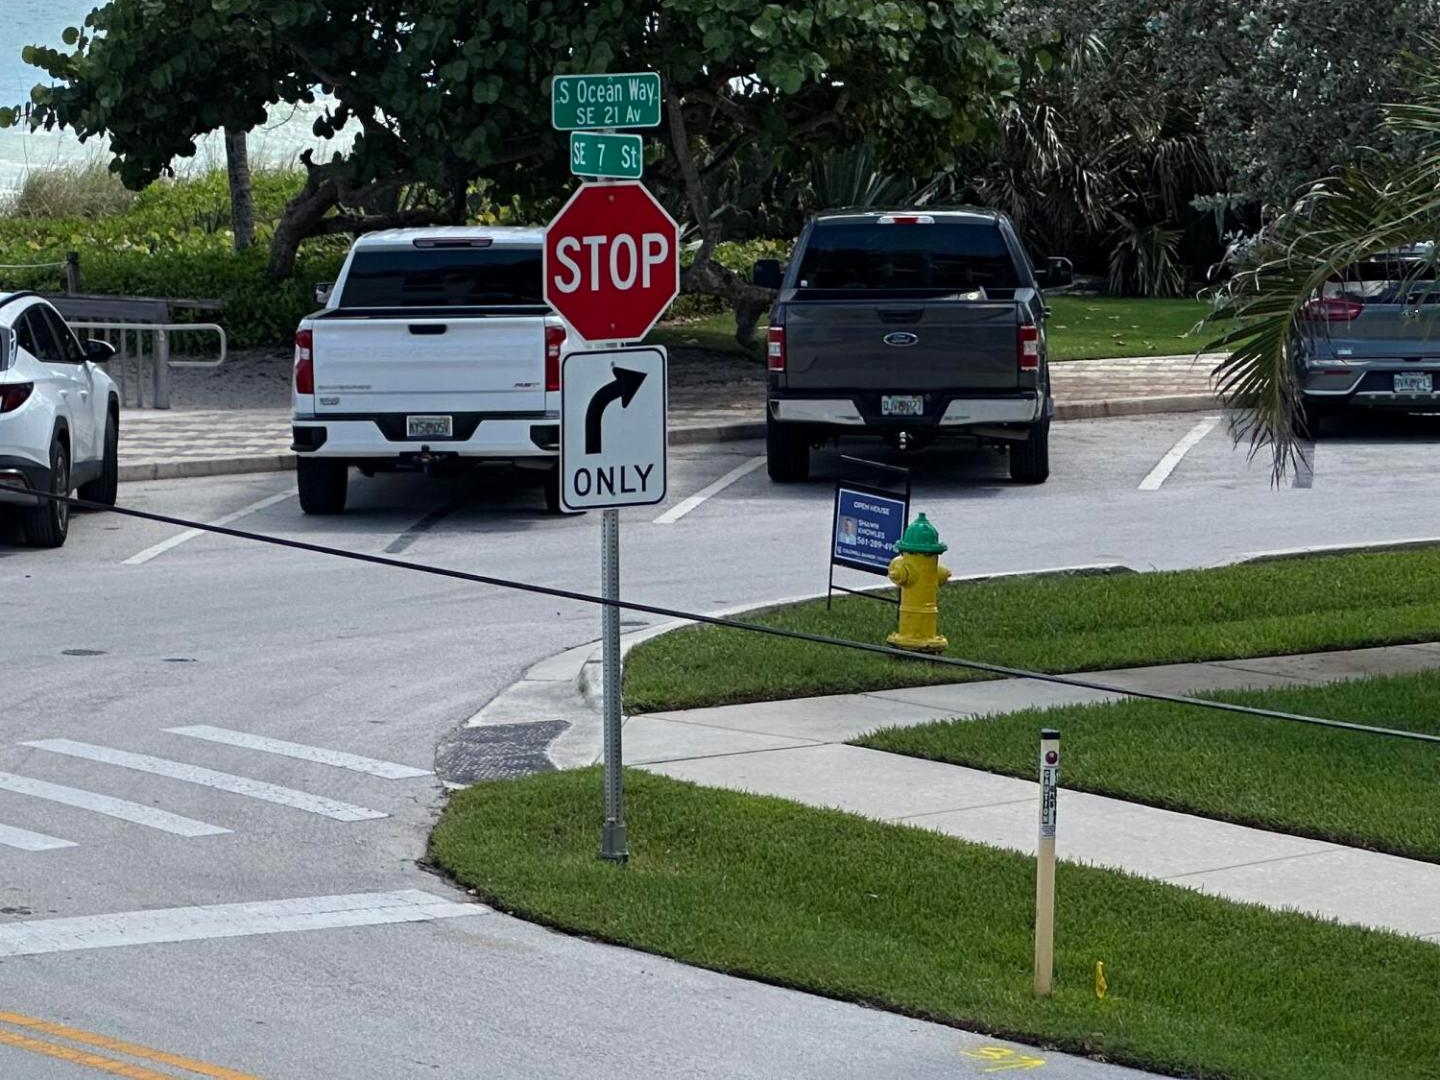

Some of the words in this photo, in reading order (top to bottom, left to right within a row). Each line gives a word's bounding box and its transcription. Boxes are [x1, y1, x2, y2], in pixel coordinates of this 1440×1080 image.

[560, 81, 569, 103] S
[576, 80, 622, 103] Ocean
[628, 78, 655, 106] Way
[576, 107, 595, 124] SE
[604, 106, 618, 124] 21
[626, 105, 641, 123] Av
[573, 142, 586, 165] SE
[597, 143, 605, 167] 7
[621, 145, 637, 169] St
[554, 233, 668, 293] STOP
[573, 464, 654, 497] ONLY
[870, 505, 890, 516] HOUSE
